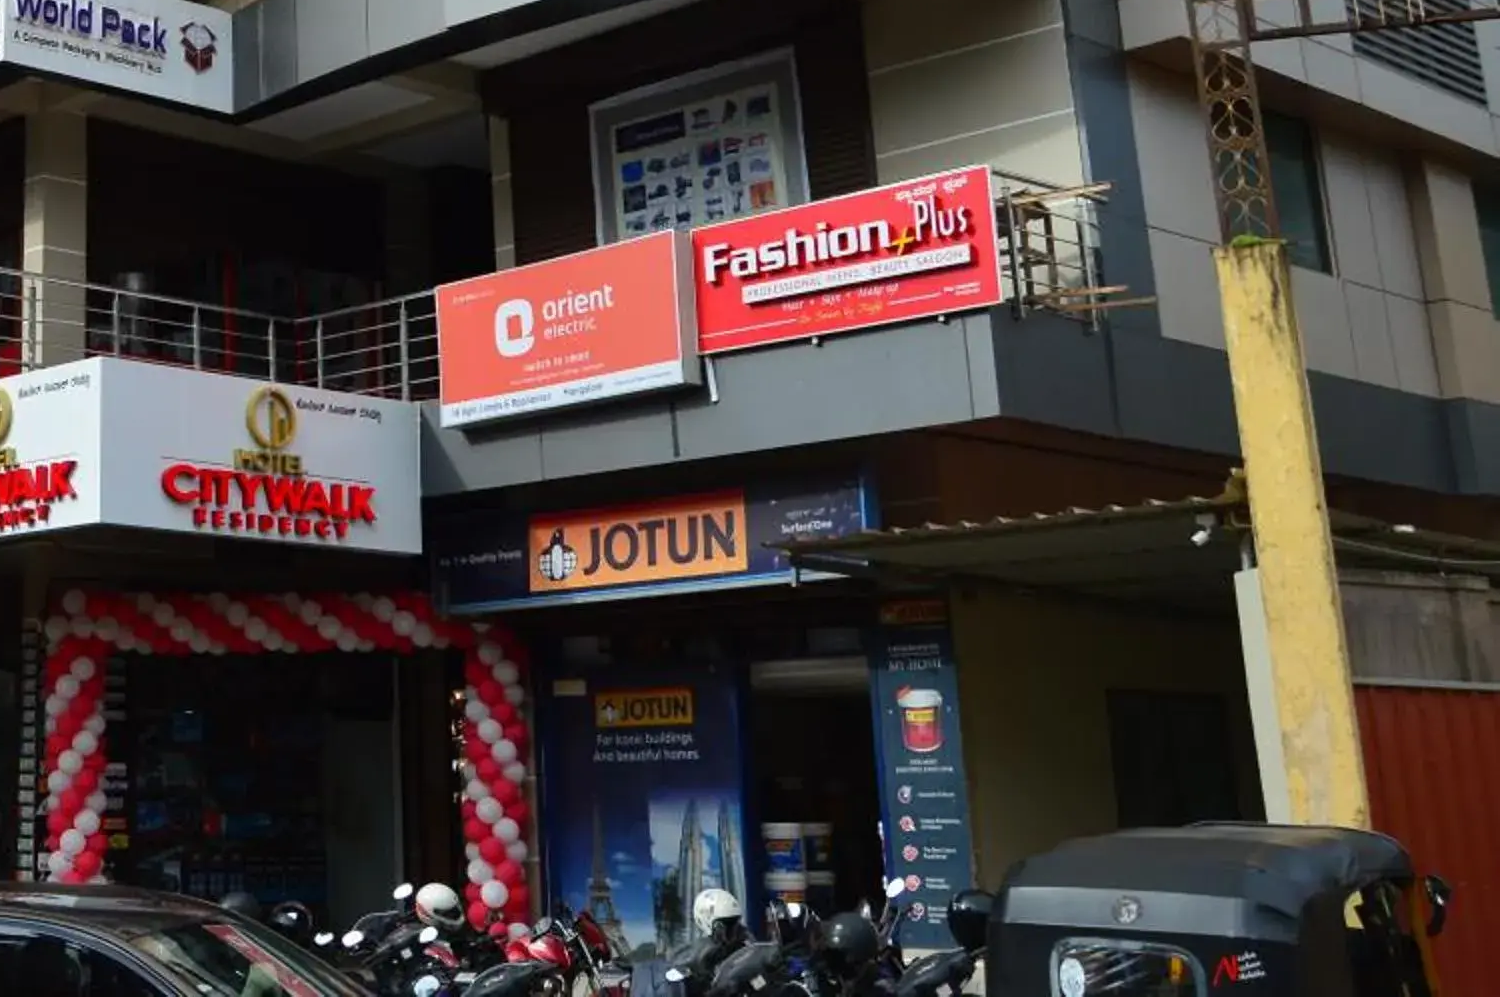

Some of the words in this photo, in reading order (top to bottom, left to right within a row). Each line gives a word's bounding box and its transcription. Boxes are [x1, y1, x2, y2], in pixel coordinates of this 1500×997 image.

[101, 5, 168, 54] Pack
[703, 220, 891, 283] Fashion
[908, 195, 967, 241] Plus
[542, 283, 615, 321] orient
[747, 277, 822, 299] PROFESSIONAL
[543, 317, 597, 341] electric
[233, 449, 307, 475] HOTEL
[161, 463, 377, 525] CITYWALK
[193, 506, 349, 539] RESIDENCY
[583, 510, 737, 577] JOTUN
[624, 697, 687, 721] JOTUN
[596, 732, 613, 746] For
[616, 748, 660, 762] beautiful
